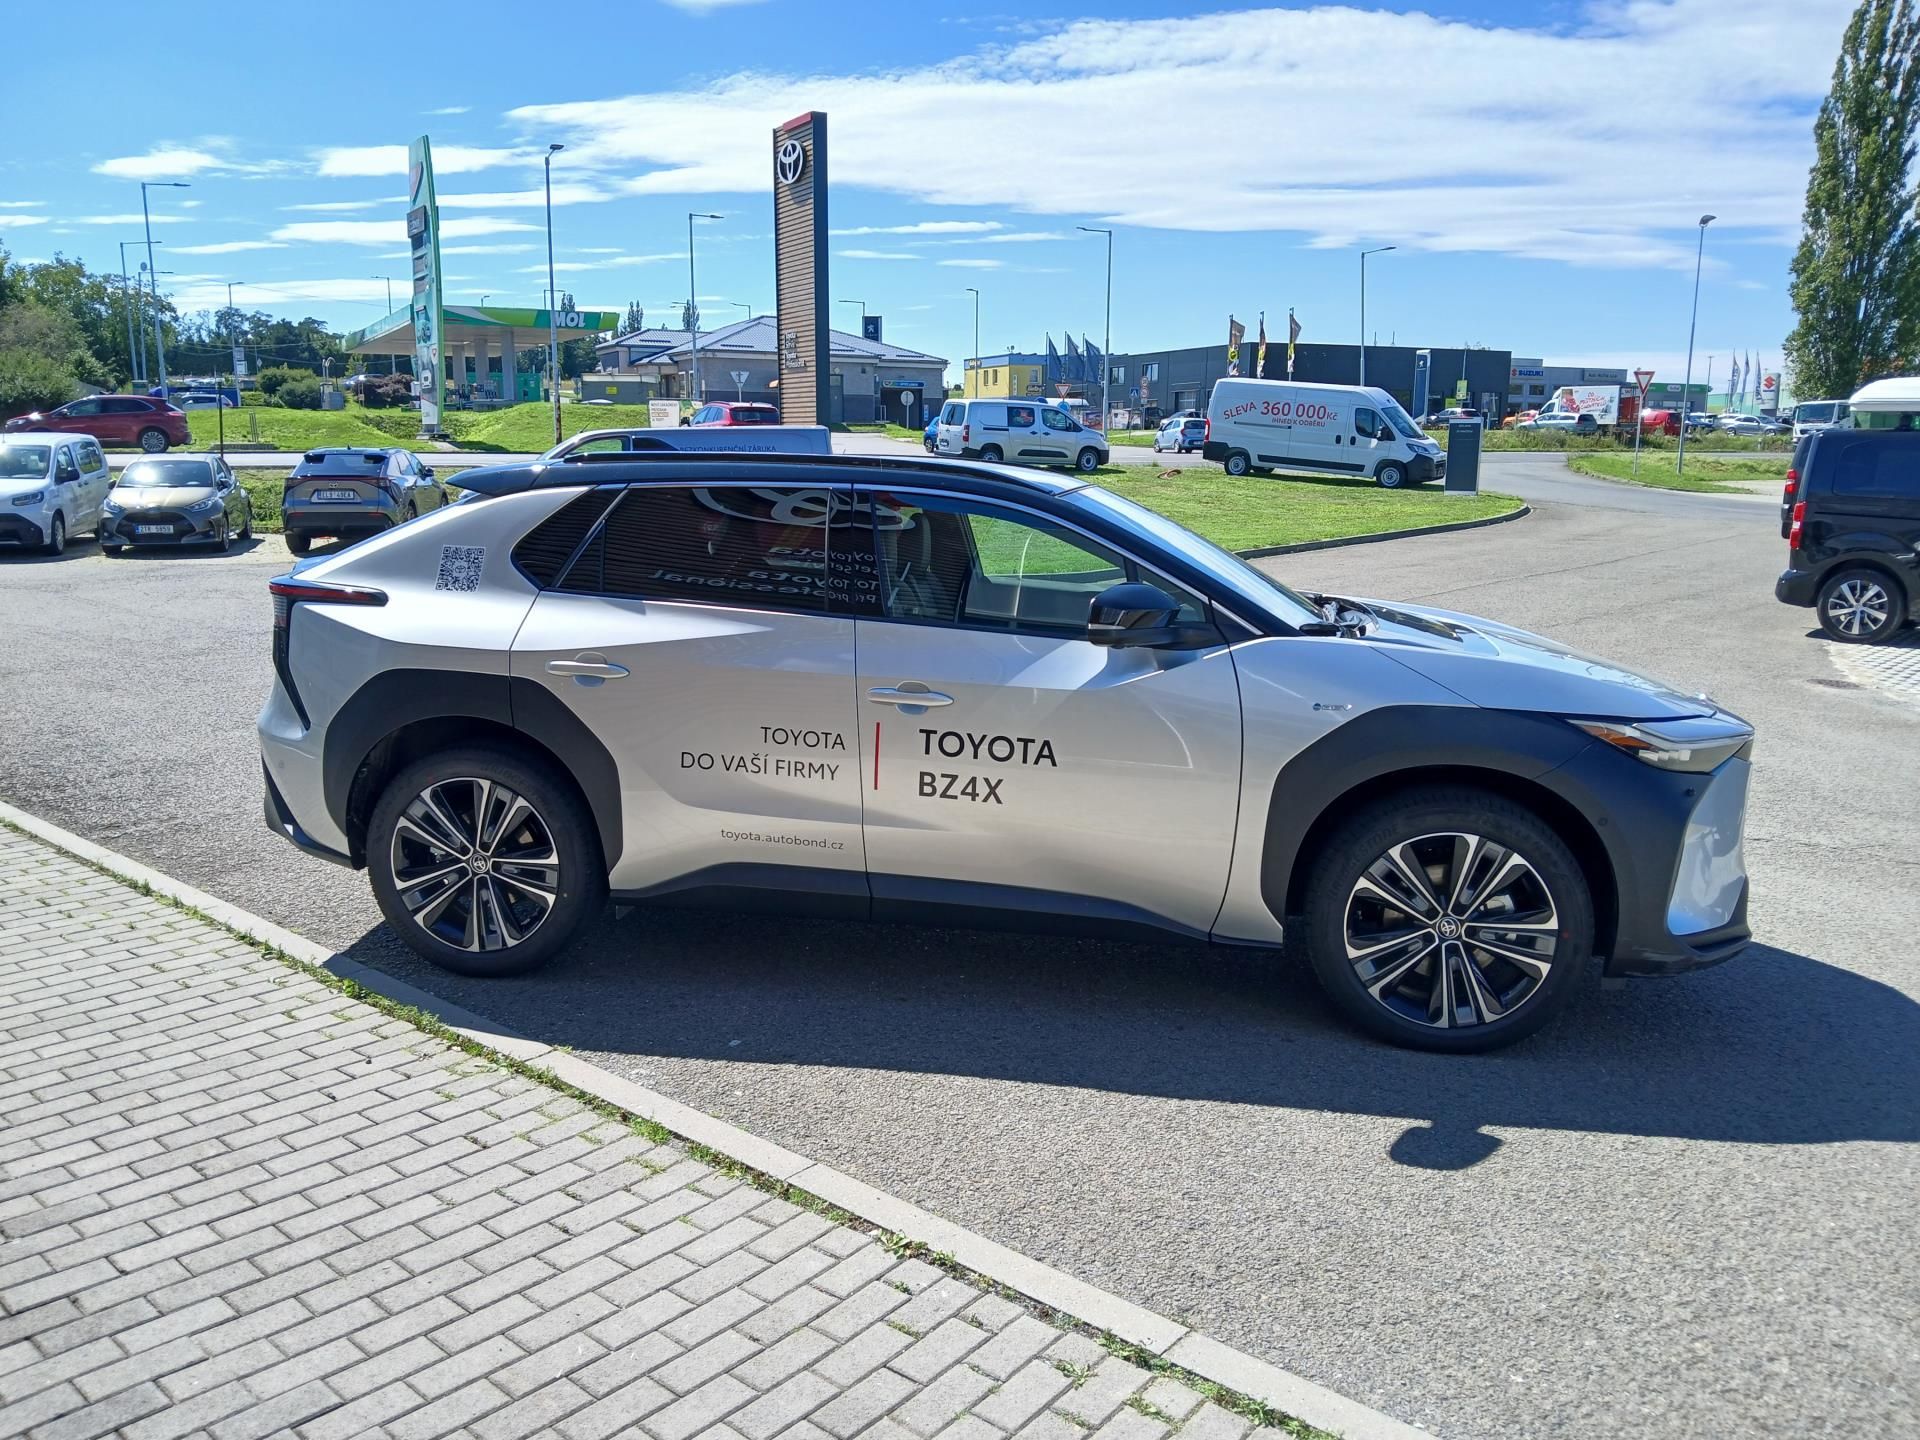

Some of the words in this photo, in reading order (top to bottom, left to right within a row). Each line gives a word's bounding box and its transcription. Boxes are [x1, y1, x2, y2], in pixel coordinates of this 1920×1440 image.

[551, 311, 586, 328] MOL
[1518, 369, 1544, 377] SUZUKI
[1223, 401, 1257, 420] SLEVA
[1260, 401, 1291, 416] 360
[1295, 403, 1327, 420] 000
[748, 444, 777, 453] ZÁRUKA
[760, 726, 846, 751] TOYOTA
[918, 728, 1058, 767] TOYOTA
[680, 751, 715, 770] DO
[721, 752, 769, 775] VAŠÍ
[775, 759, 840, 781] FIRMY
[918, 771, 1004, 805] BZ4X
[720, 829, 844, 850] toyota.autobond.cz
